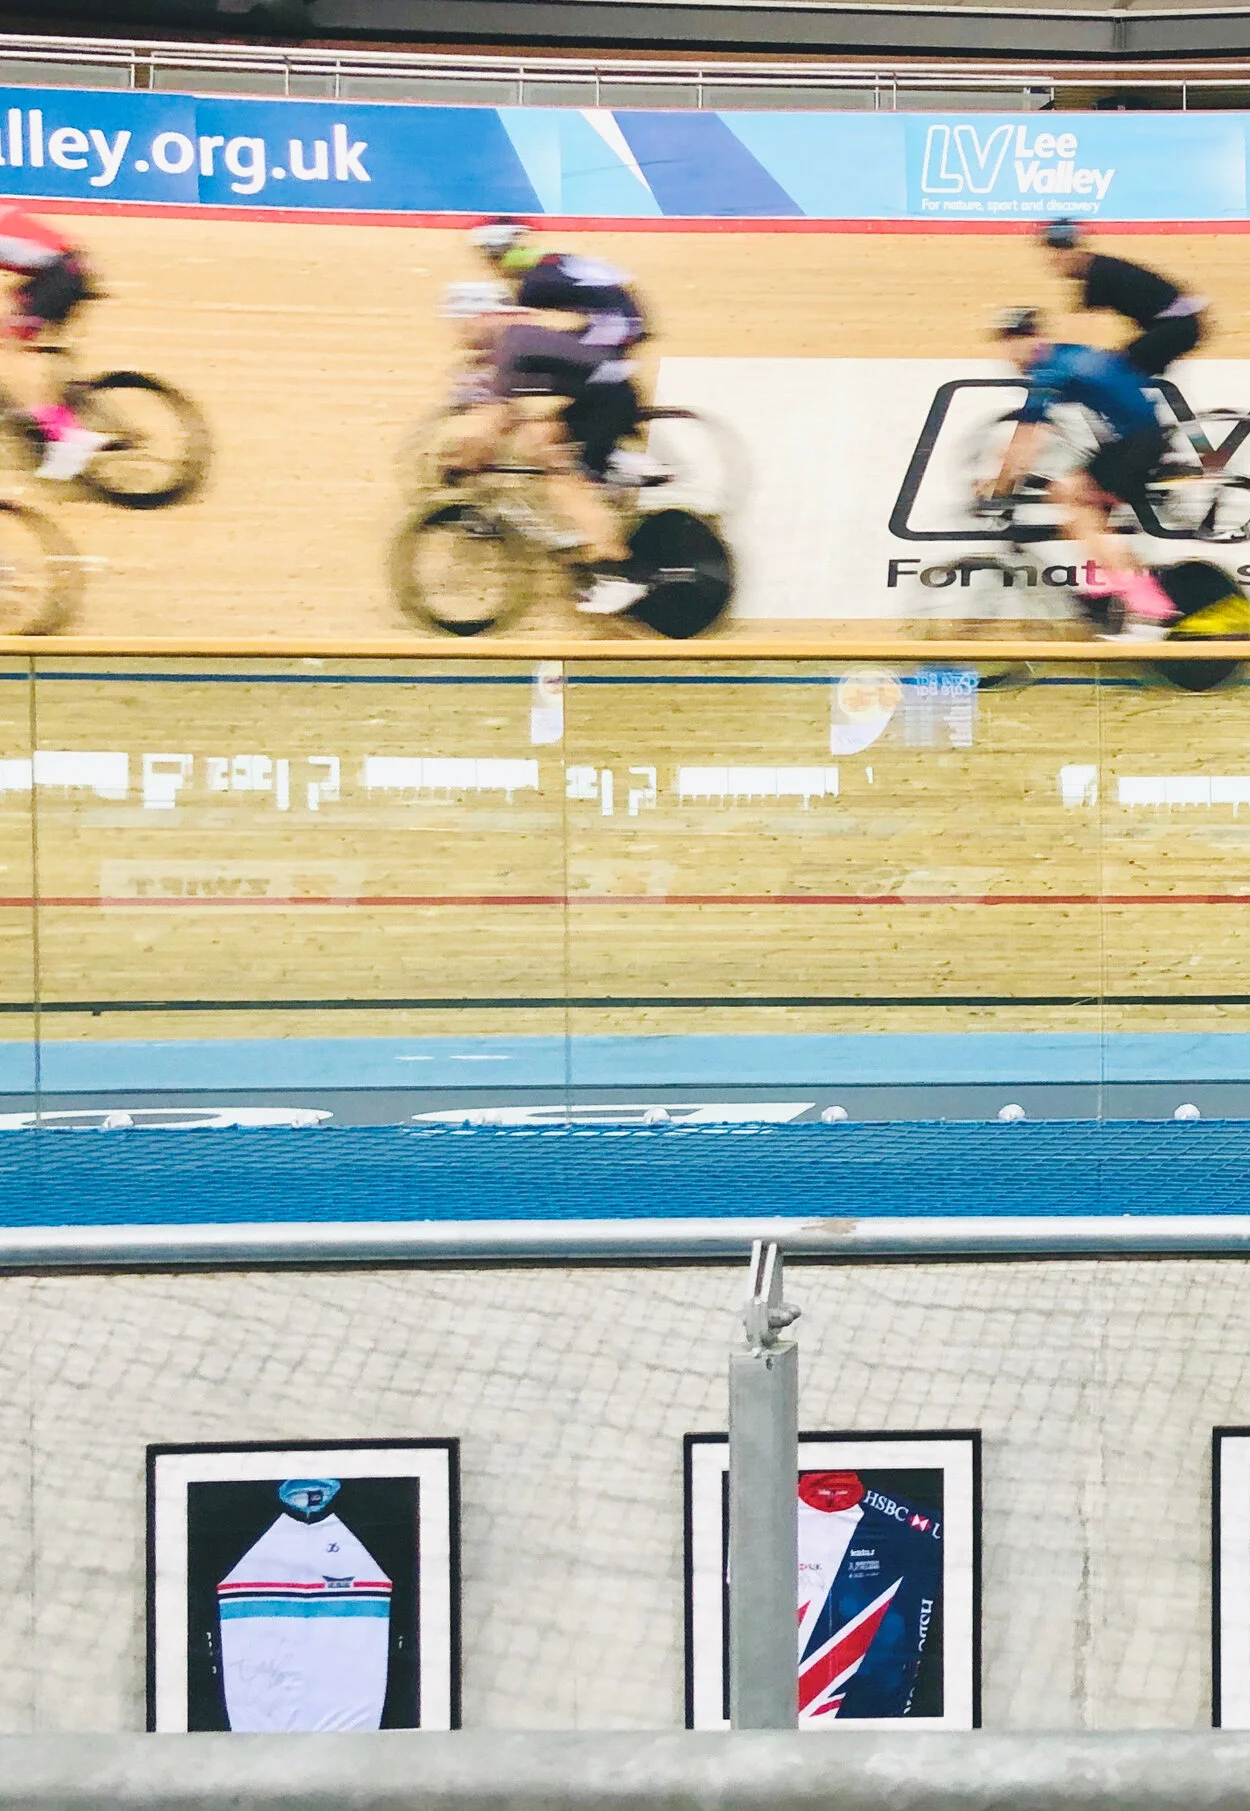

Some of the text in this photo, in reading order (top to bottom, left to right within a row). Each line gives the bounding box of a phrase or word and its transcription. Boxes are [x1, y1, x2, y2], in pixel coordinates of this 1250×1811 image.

[0, 108, 371, 195] lley.org.uk
[1015, 124, 1078, 159] Lee
[1014, 160, 1116, 200] Valley
[921, 198, 941, 211] For
[987, 199, 1018, 214] sport
[1020, 199, 1044, 211] and
[1046, 199, 1101, 214] discovery
[886, 558, 978, 589] For
[863, 1490, 909, 1522] HSBC
